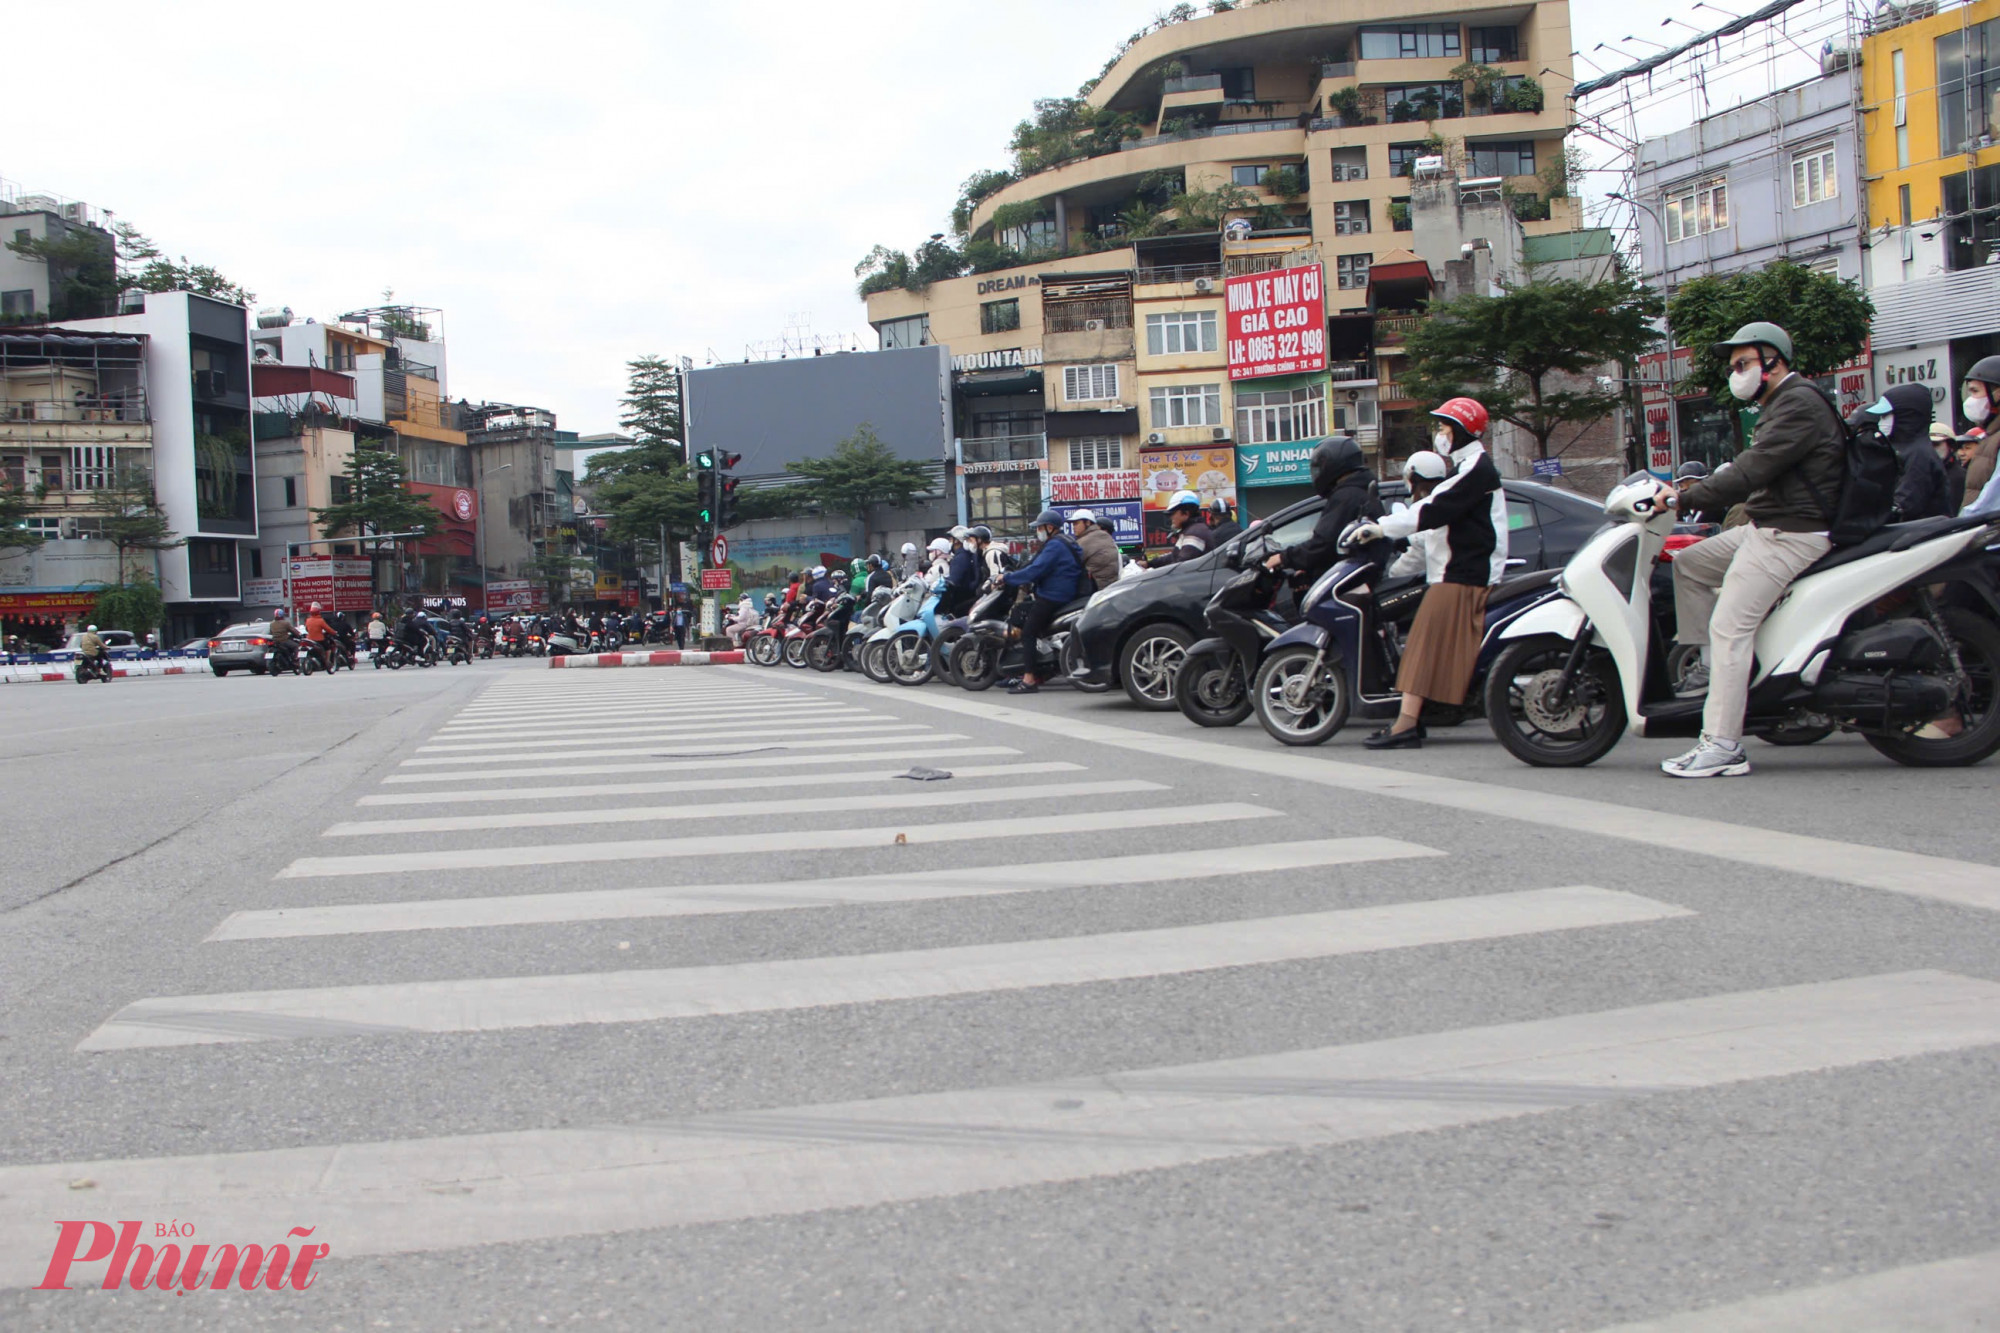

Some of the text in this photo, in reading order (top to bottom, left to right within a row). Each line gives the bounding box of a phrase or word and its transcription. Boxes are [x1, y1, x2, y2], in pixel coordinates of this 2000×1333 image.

[977, 275, 1026, 295] DREAM
[1228, 266, 1319, 312] MUA XE MÁY CŨ
[1241, 306, 1308, 334] GIÁ CAO
[1228, 328, 1323, 365] LH: 0865 322 998
[951, 348, 1043, 370] MOUNTAIN
[1300, 360, 1308, 369] TX
[1266, 451, 1279, 463] IN
[964, 461, 1039, 474] COFFEE JUICE TEA
[1052, 482, 1080, 501] CHUNG
[1082, 481, 1099, 500] NGA
